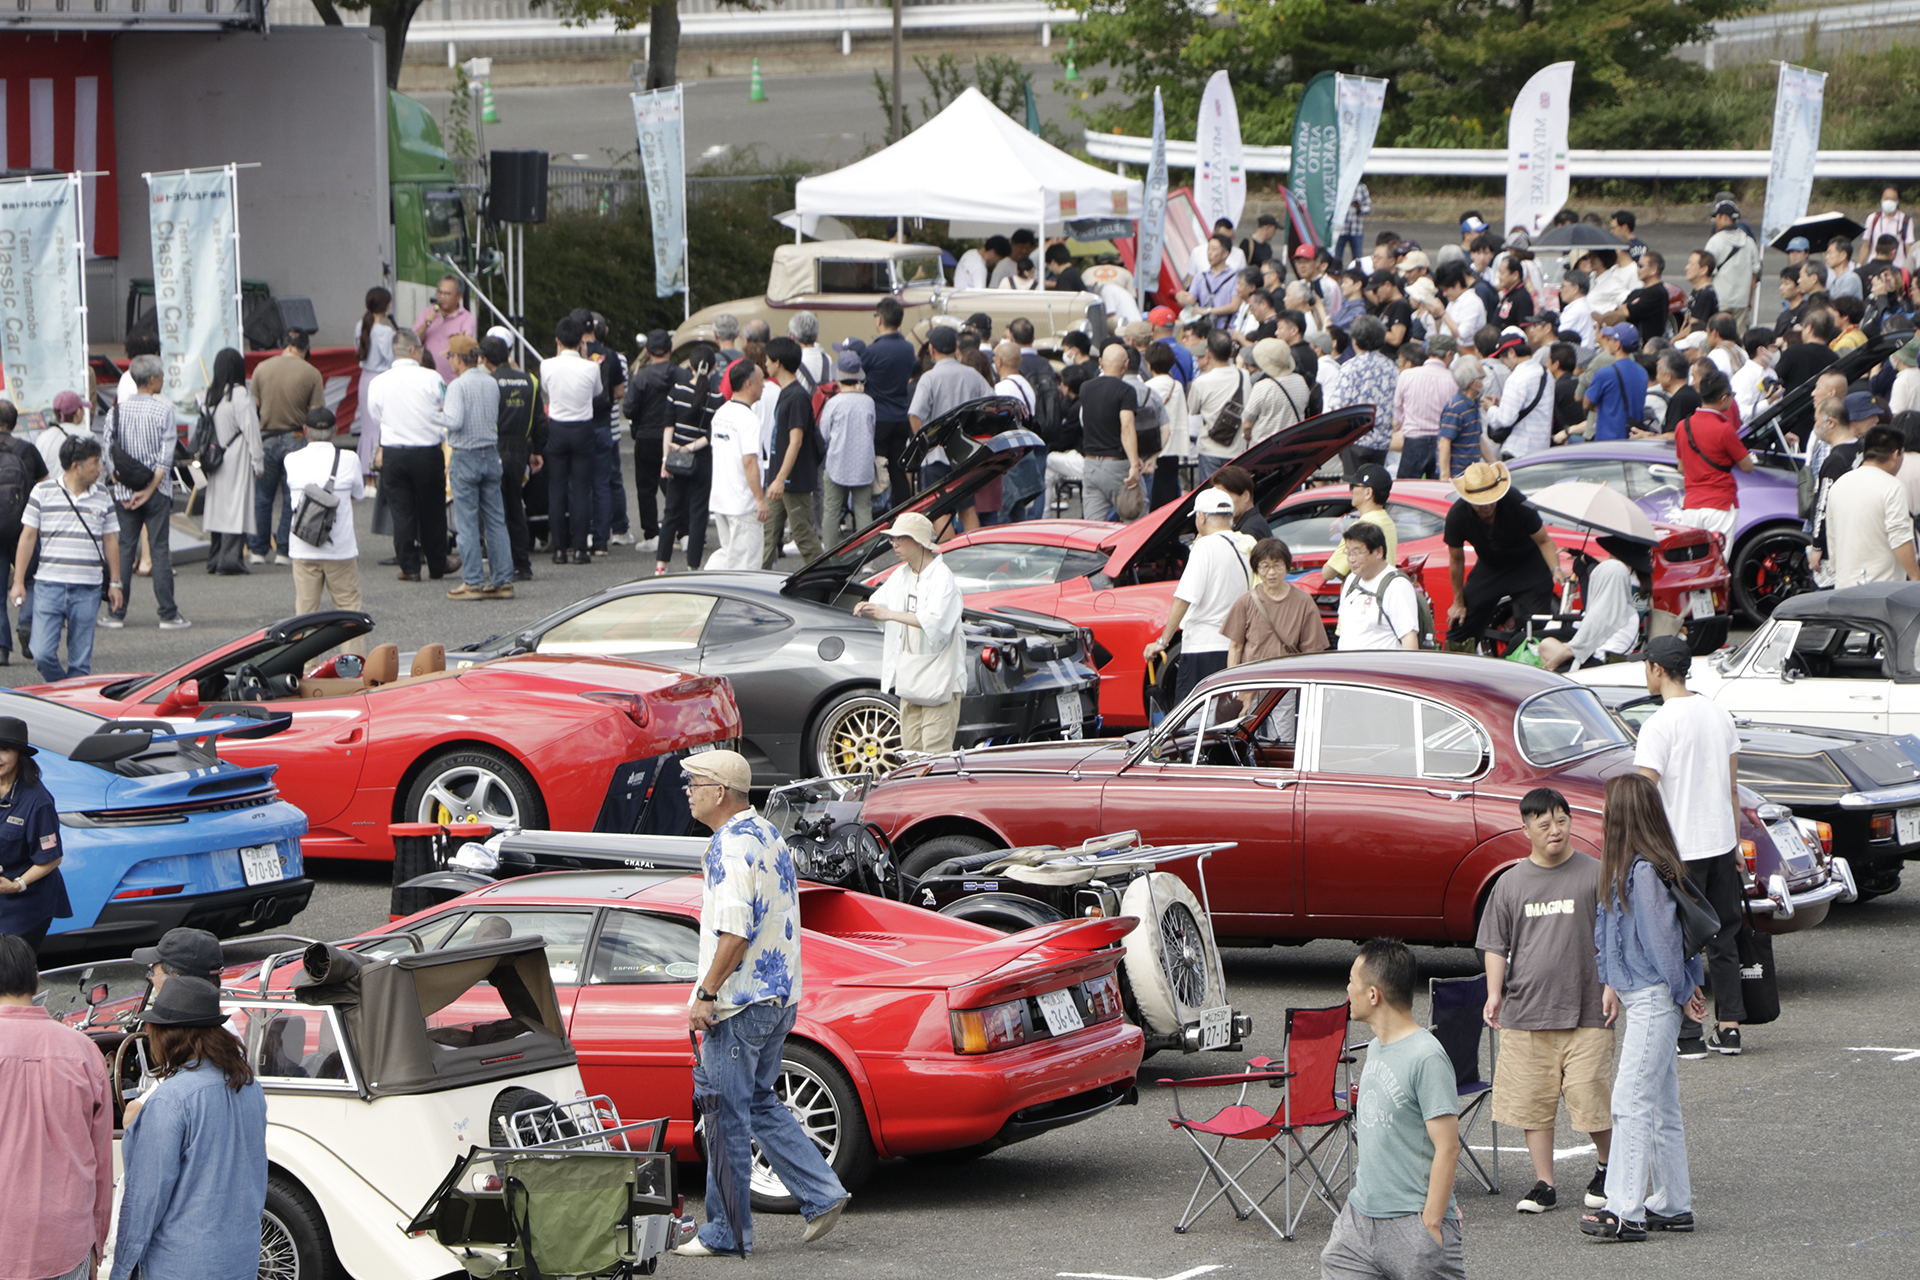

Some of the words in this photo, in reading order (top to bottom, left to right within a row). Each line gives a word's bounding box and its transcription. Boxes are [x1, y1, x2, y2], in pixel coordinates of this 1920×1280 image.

[1151, 131, 1165, 191] Classic
[655, 201, 666, 230] Car
[1147, 197, 1163, 227] Car
[19, 228, 33, 264] Tenri
[179, 218, 191, 255] Tenri
[1142, 232, 1158, 262] Fes
[0, 228, 19, 308] Classic
[158, 220, 179, 298] Classic
[22, 267, 39, 340] Yamanobe
[182, 258, 197, 328] Yamanobe
[5, 316, 24, 355] Car
[164, 306, 183, 344] Car
[168, 353, 185, 389] Fes
[457, 756, 502, 772] MICHELIN
[252, 812, 266, 820] GT3
[252, 859, 281, 881] 70-85
[624, 859, 655, 869] CHAPAL
[1525, 899, 1575, 917] IMAGINE
[1050, 1004, 1081, 1030] 36-43
[1206, 1022, 1230, 1047] 27-15
[1377, 1061, 1409, 1109] FOOTBALL
